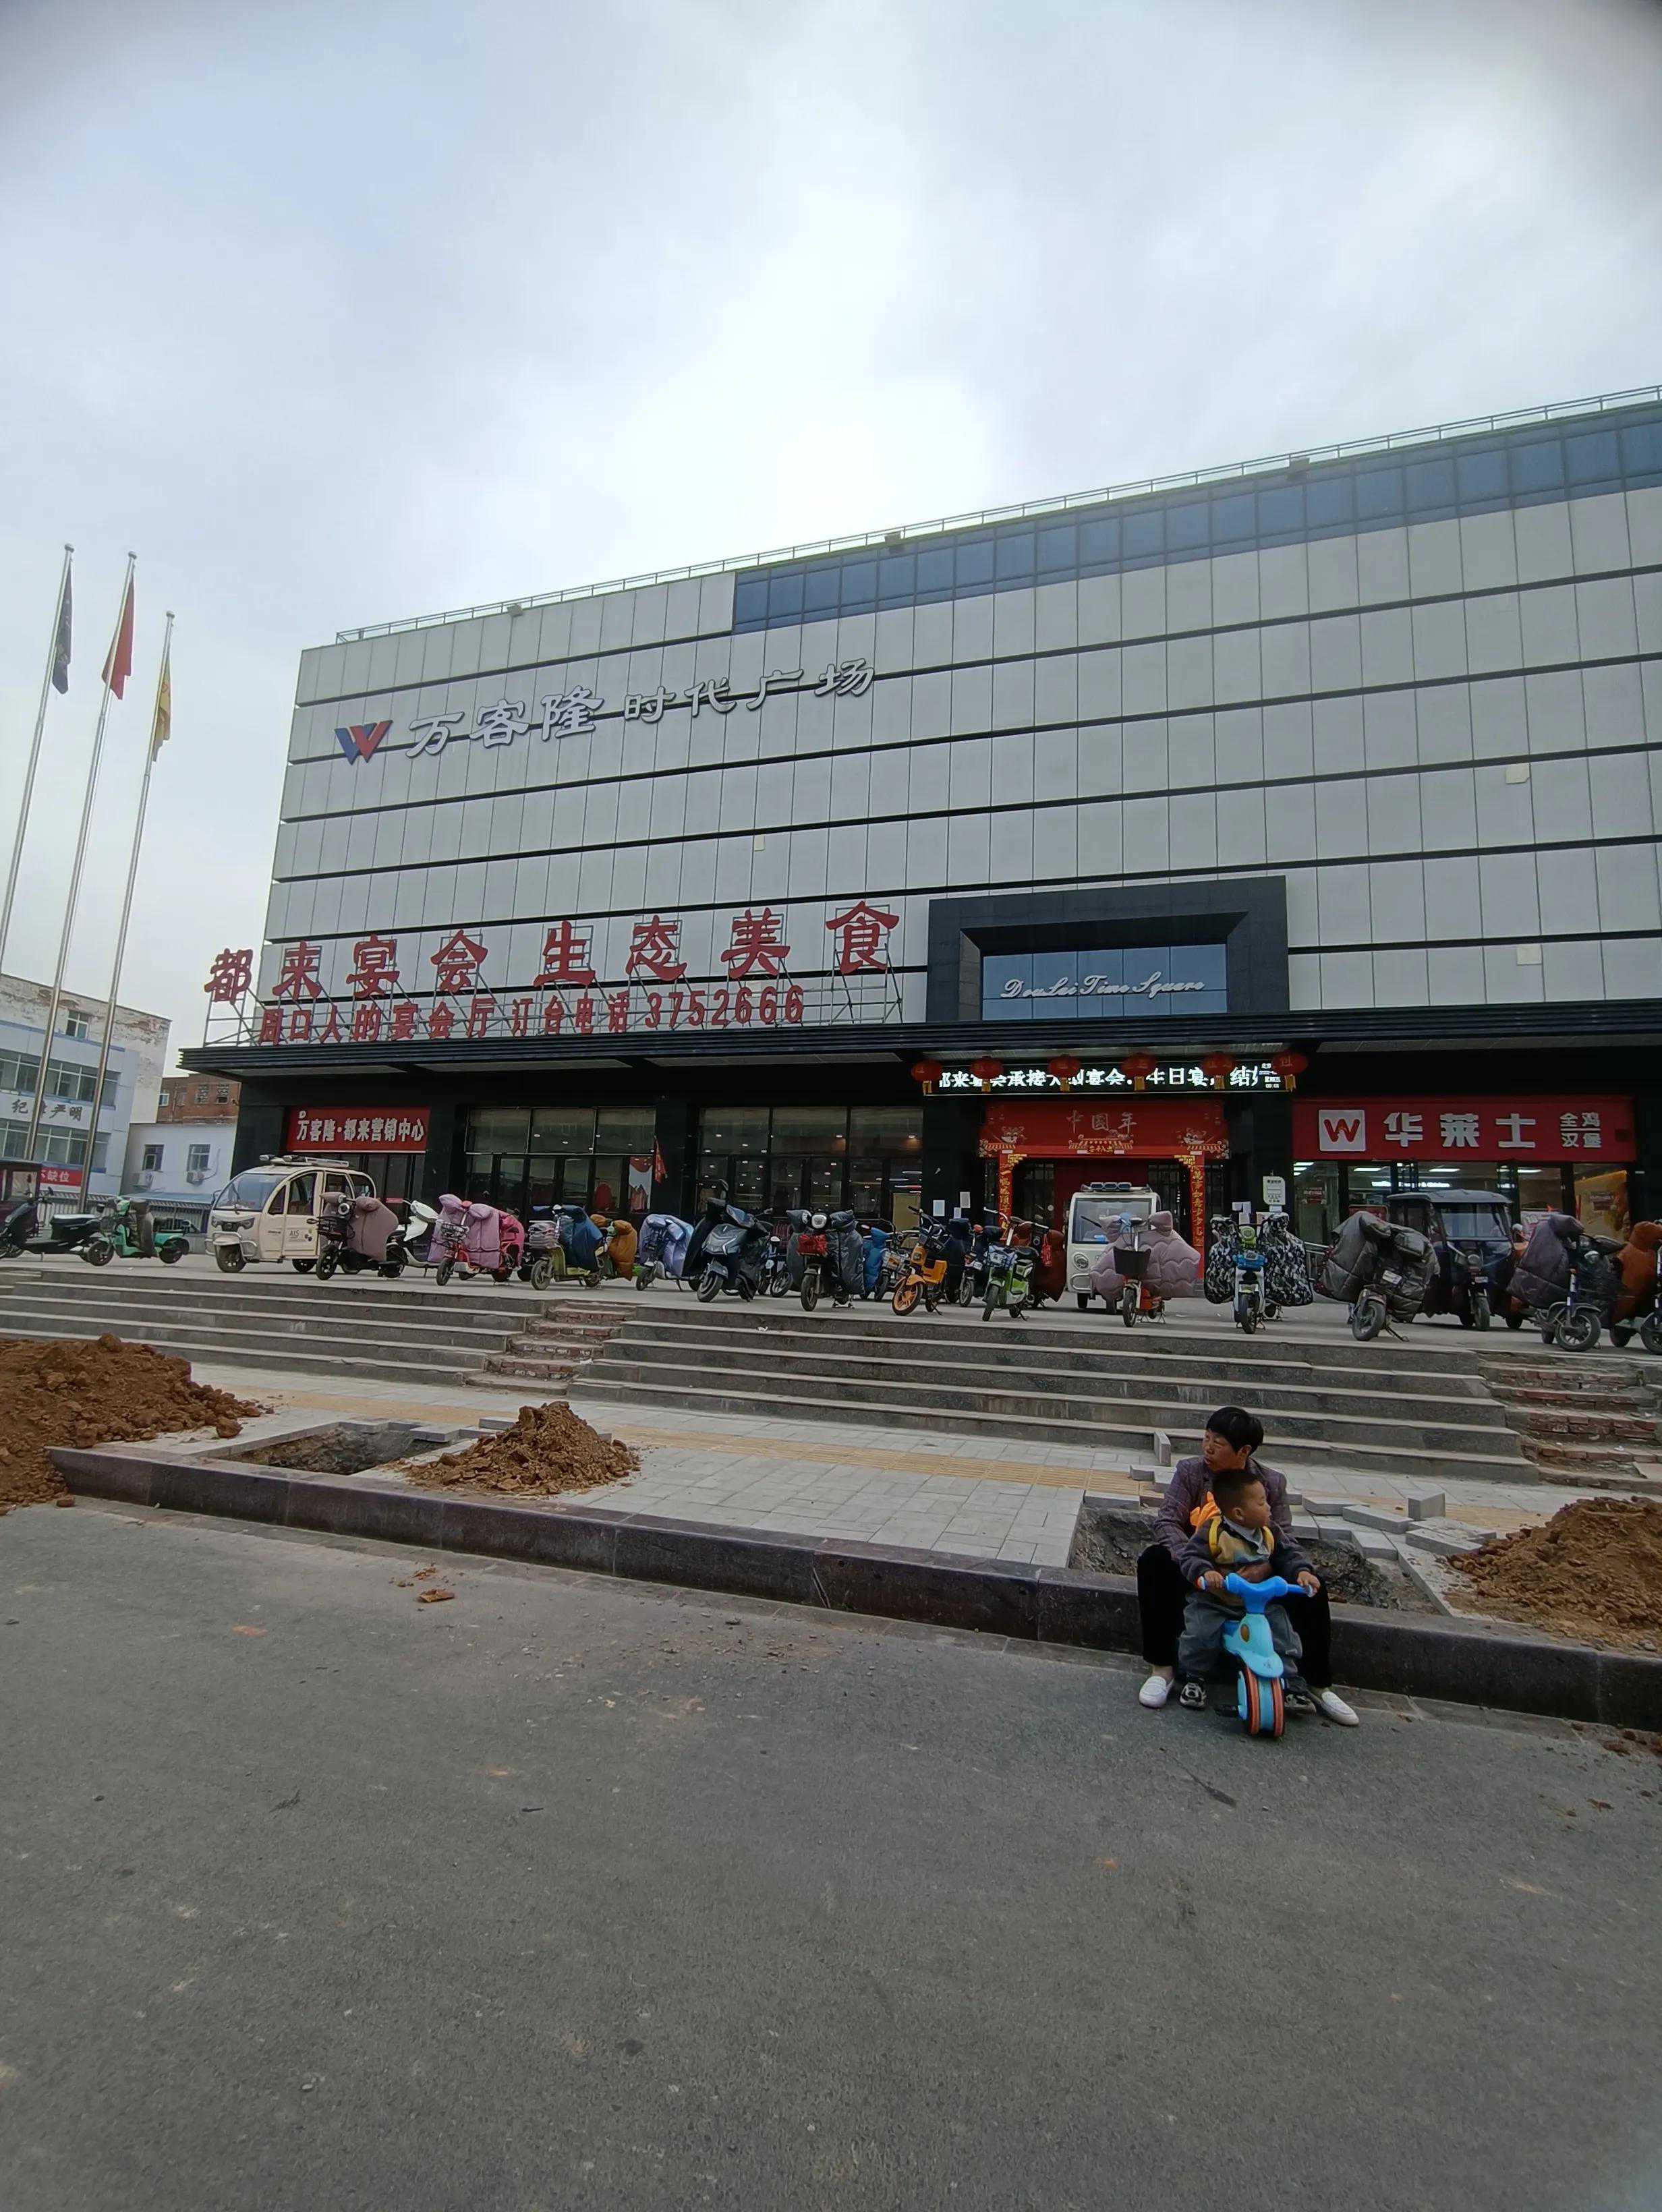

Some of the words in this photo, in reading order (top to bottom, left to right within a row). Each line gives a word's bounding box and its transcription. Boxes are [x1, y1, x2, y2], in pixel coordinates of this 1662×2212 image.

[1081, 974, 1130, 995] Time
[1133, 971, 1205, 999] Square
[1384, 1112, 1536, 1147] 华莱士
[1560, 1112, 1601, 1127] 全鸡
[1561, 1132, 1602, 1148] 汉堡
